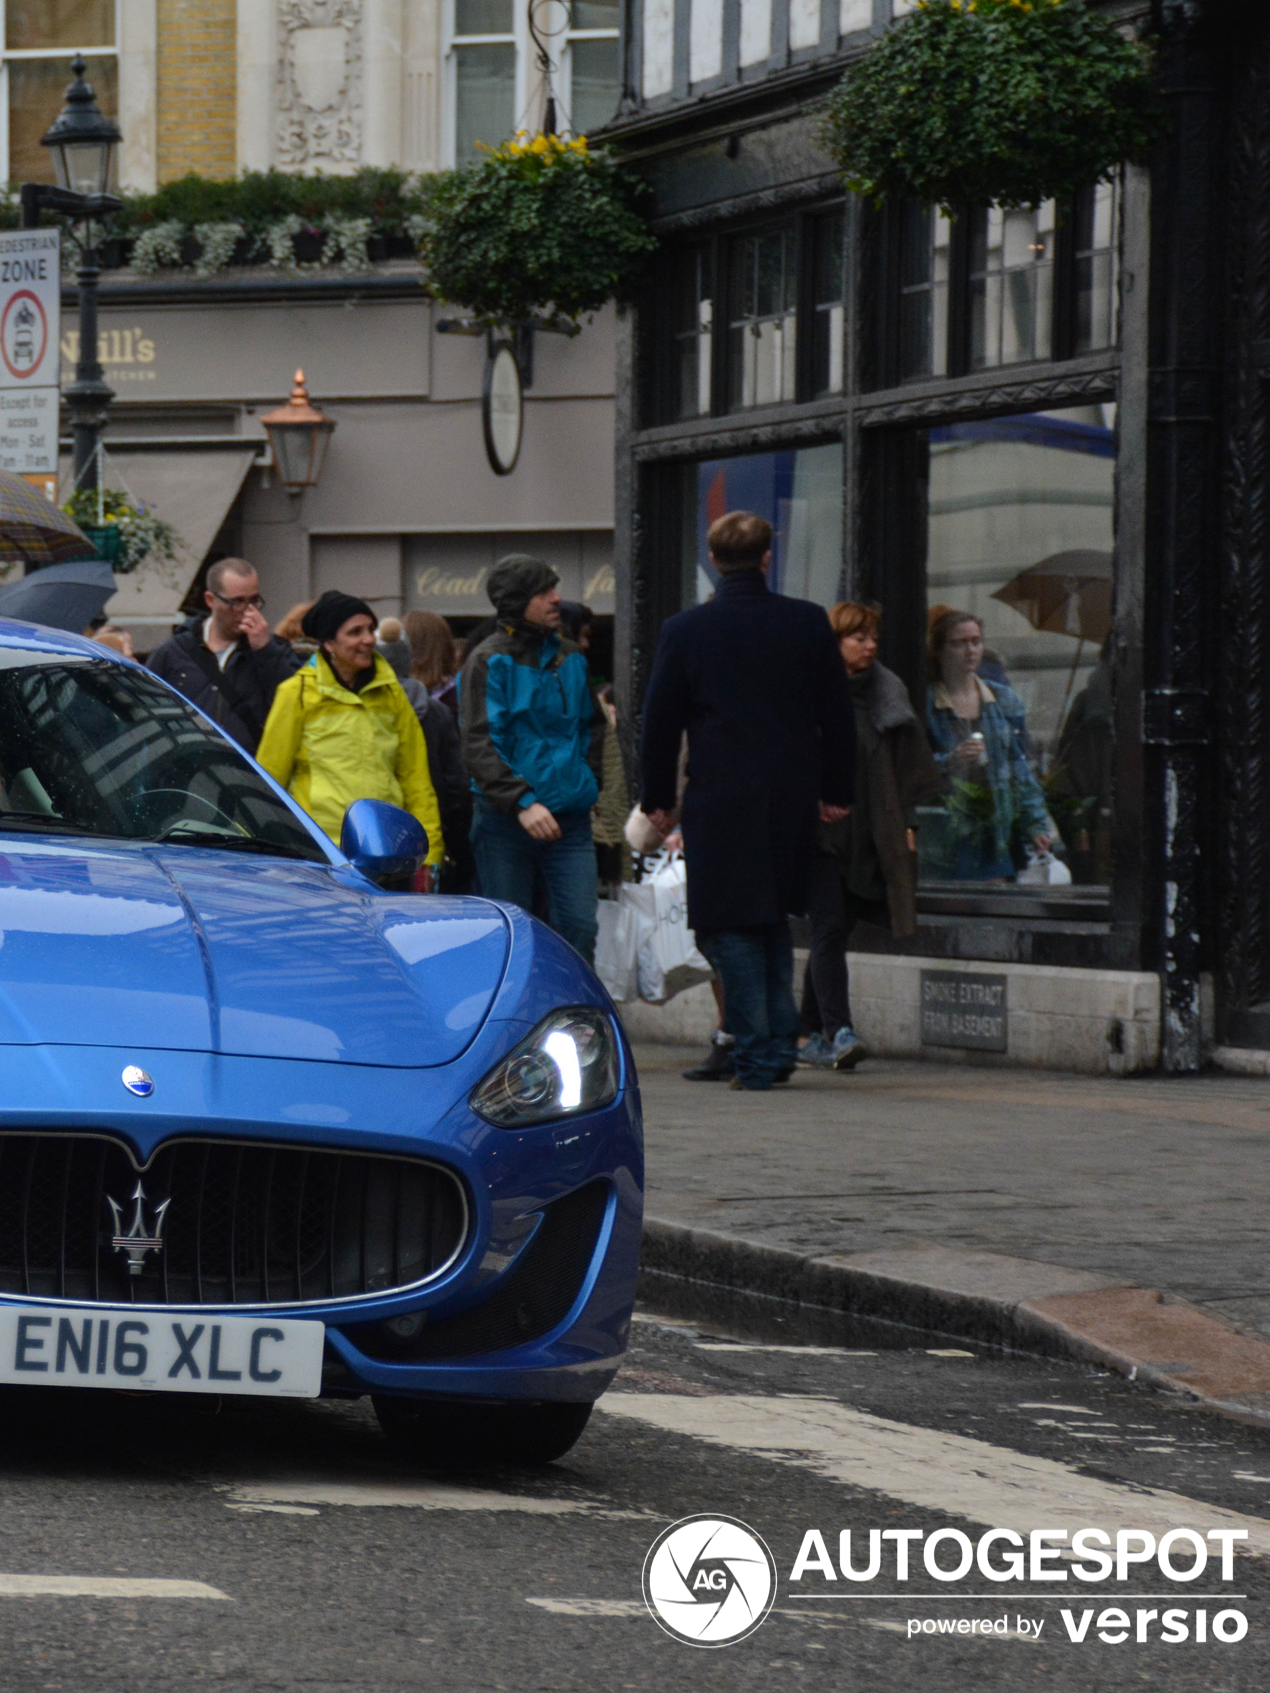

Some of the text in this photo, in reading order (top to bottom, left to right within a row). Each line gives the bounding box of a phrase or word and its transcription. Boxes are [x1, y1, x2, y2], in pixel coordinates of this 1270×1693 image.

[1, 258, 47, 282] ZONE
[0, 395, 48, 410] Except for
[7, 417, 38, 428] access
[0, 435, 19, 448] Mon
[28, 434, 46, 448] Sat
[924, 981, 1003, 1005] SMOKE EXTRACT
[924, 1011, 1003, 1037] FROM BASEMENT
[15, 1315, 285, 1383] EN16 XLC
